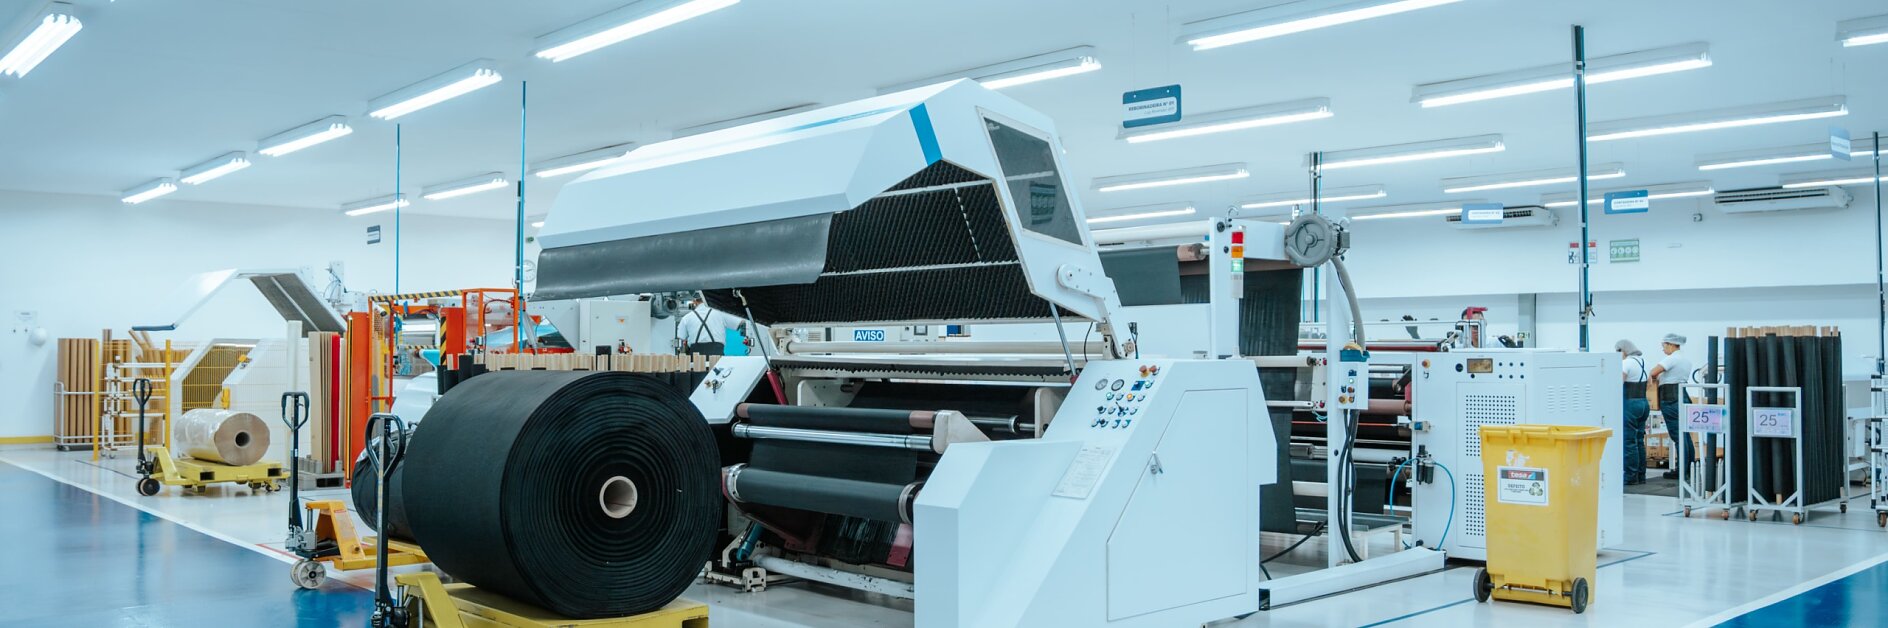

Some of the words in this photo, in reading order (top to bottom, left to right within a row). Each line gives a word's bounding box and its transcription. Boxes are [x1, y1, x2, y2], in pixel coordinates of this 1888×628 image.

[855, 330, 884, 340] AVISO
[1692, 411, 1709, 423] 25
[1760, 414, 1777, 426] 25
